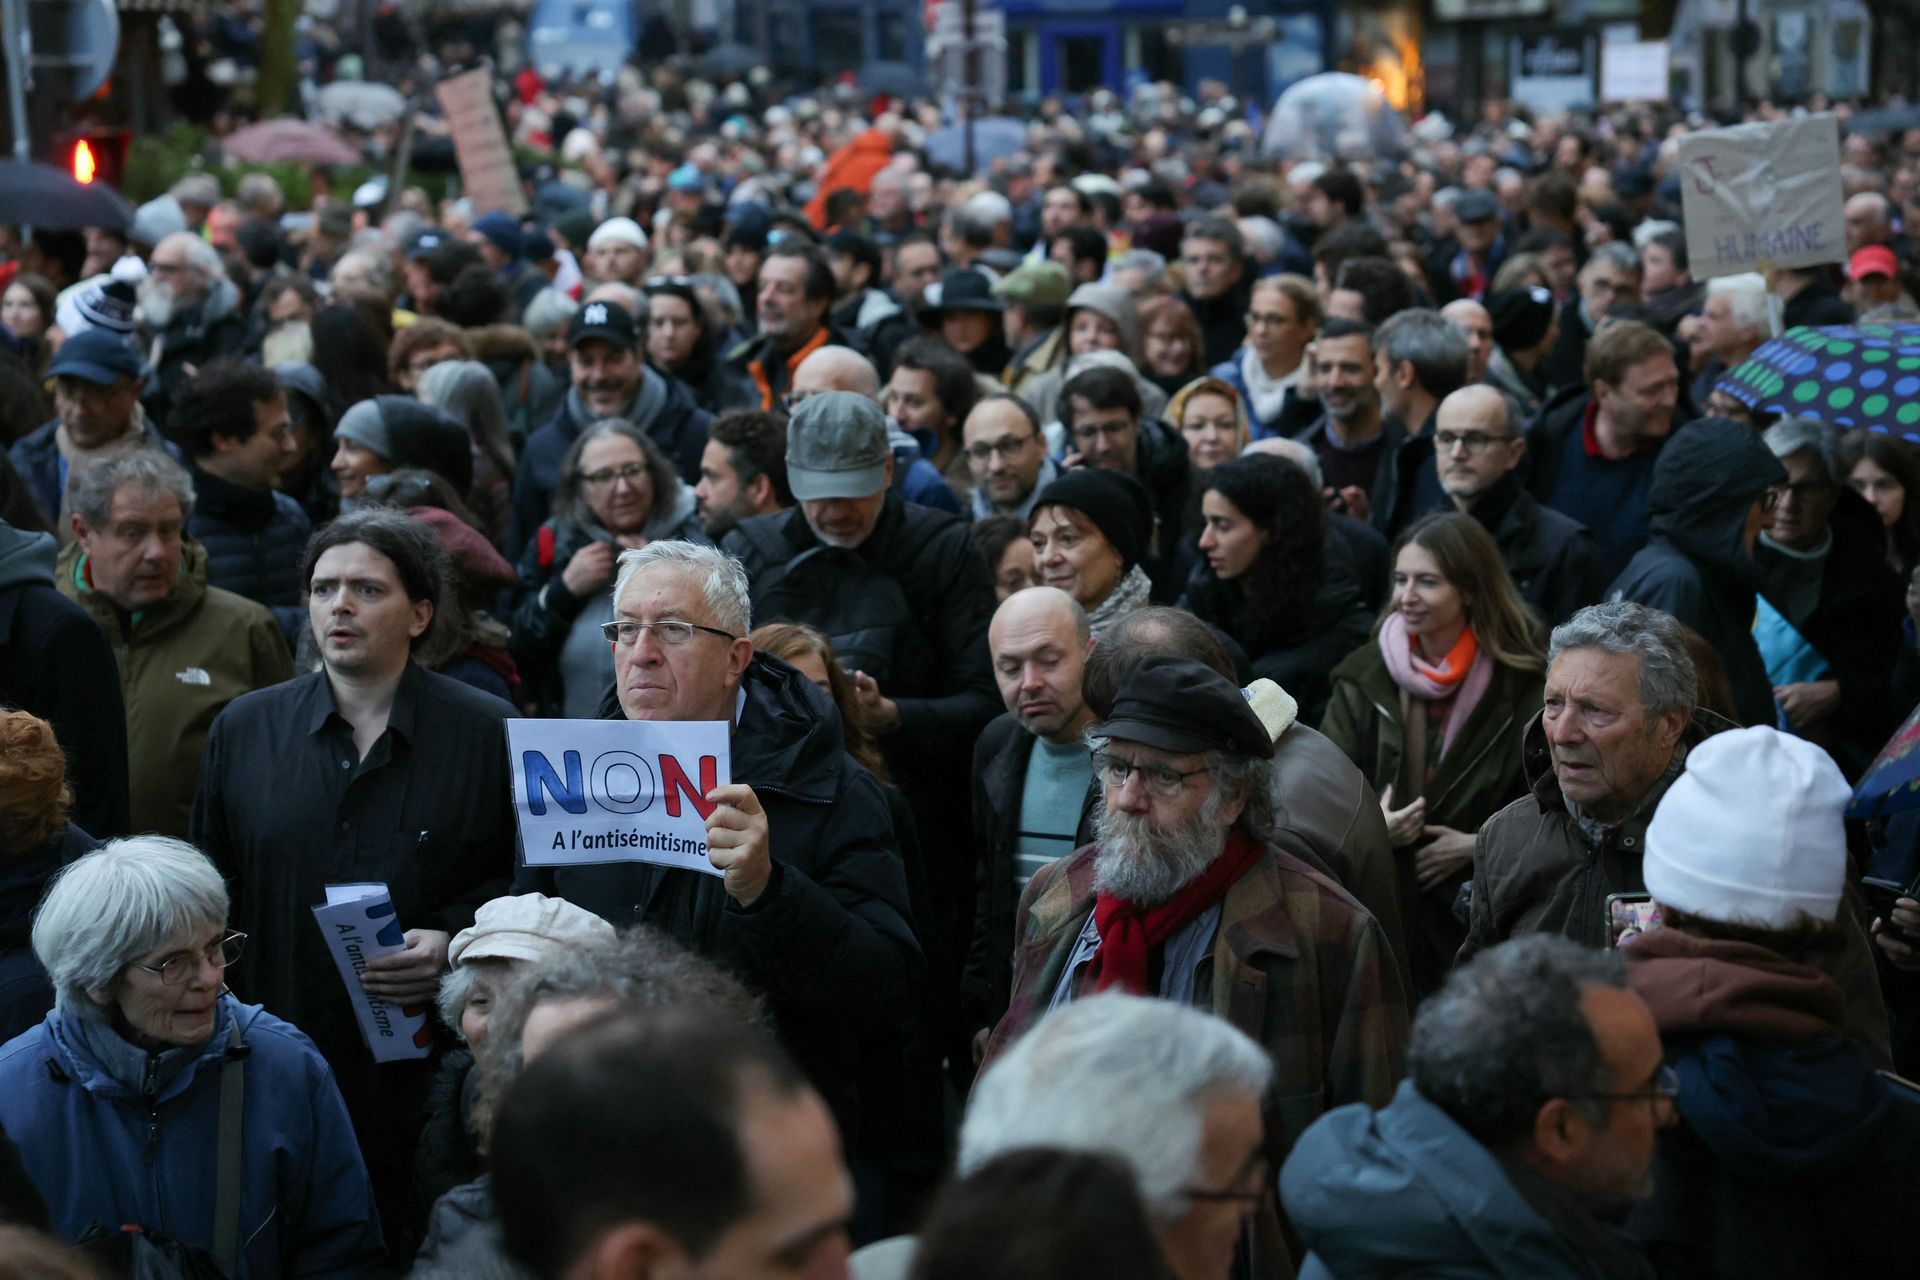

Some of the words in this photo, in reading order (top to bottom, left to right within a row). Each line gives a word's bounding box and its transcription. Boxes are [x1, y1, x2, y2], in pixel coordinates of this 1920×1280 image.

[522, 749, 718, 822] NON
[552, 831, 566, 850] A
[571, 828, 707, 857] l'antisémitisme
[335, 923, 352, 935] A
[341, 934, 394, 1037] l'antisitisme
